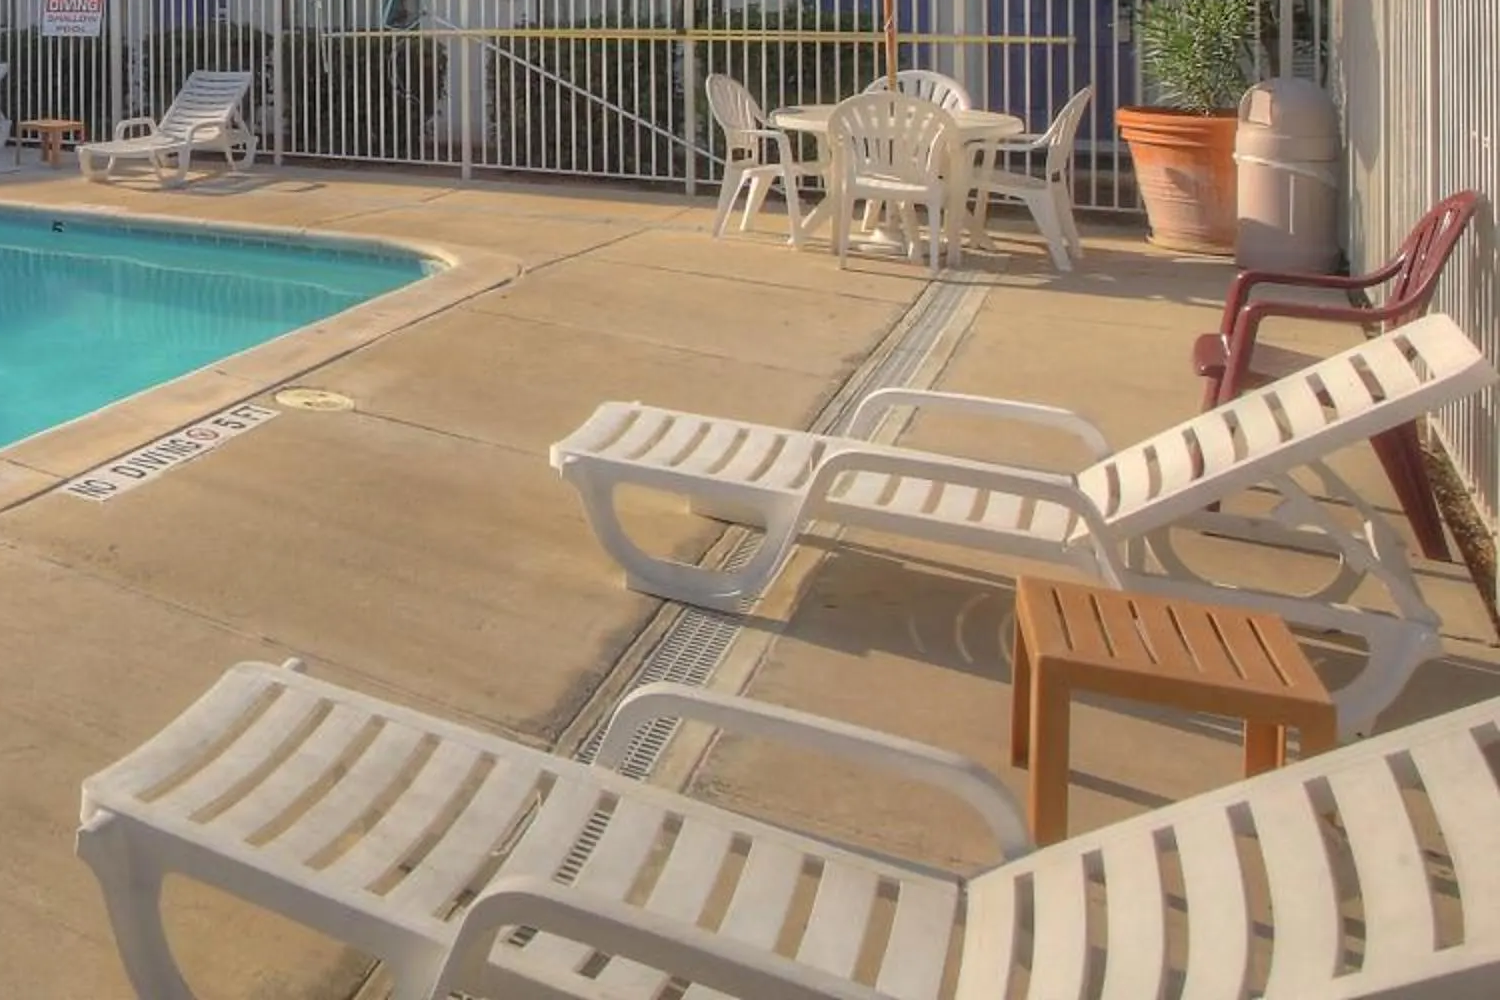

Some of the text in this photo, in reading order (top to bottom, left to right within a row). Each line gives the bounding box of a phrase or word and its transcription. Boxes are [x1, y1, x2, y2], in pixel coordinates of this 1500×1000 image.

[67, 405, 273, 499] NO DIVING 5 FT
